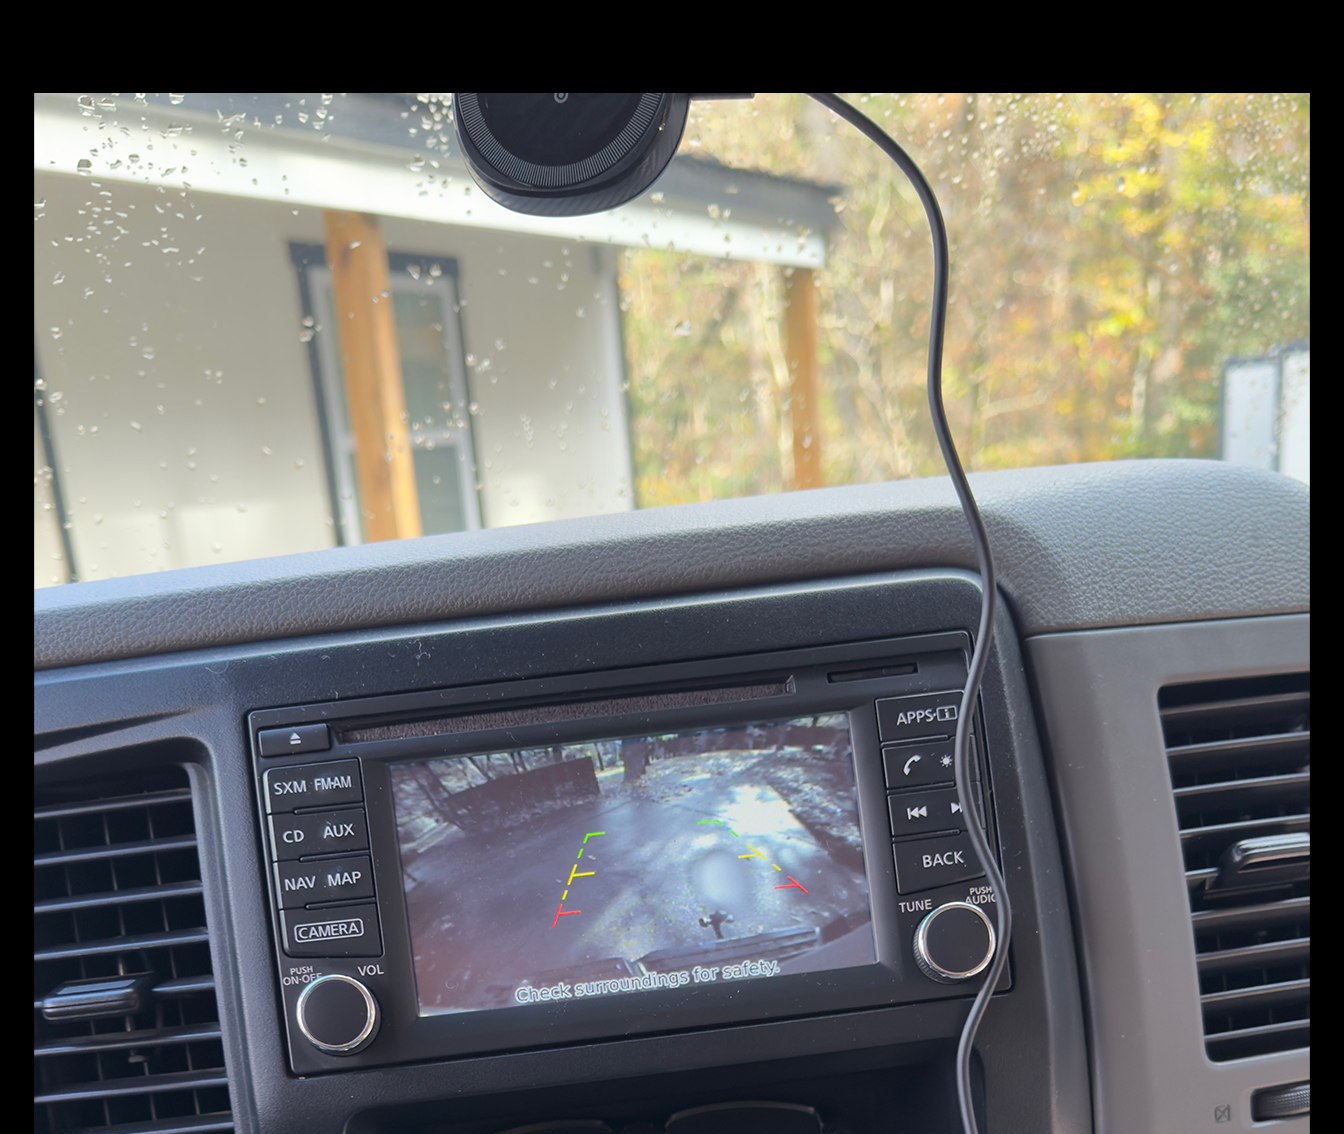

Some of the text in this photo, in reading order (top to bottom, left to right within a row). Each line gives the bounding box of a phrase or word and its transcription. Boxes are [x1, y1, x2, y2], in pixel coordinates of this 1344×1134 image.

[273, 780, 307, 795] SXM
[282, 823, 355, 843] CD AUX
[922, 851, 964, 869] BACK
[284, 871, 362, 891] NAV MAP
[969, 886, 992, 895] PUSH
[898, 899, 932, 913] TUNE
[298, 922, 359, 939] CAMERA
[290, 966, 313, 975] PUSH
[357, 964, 384, 976] VOL
[515, 960, 780, 1003] Check surroundings for safety.
